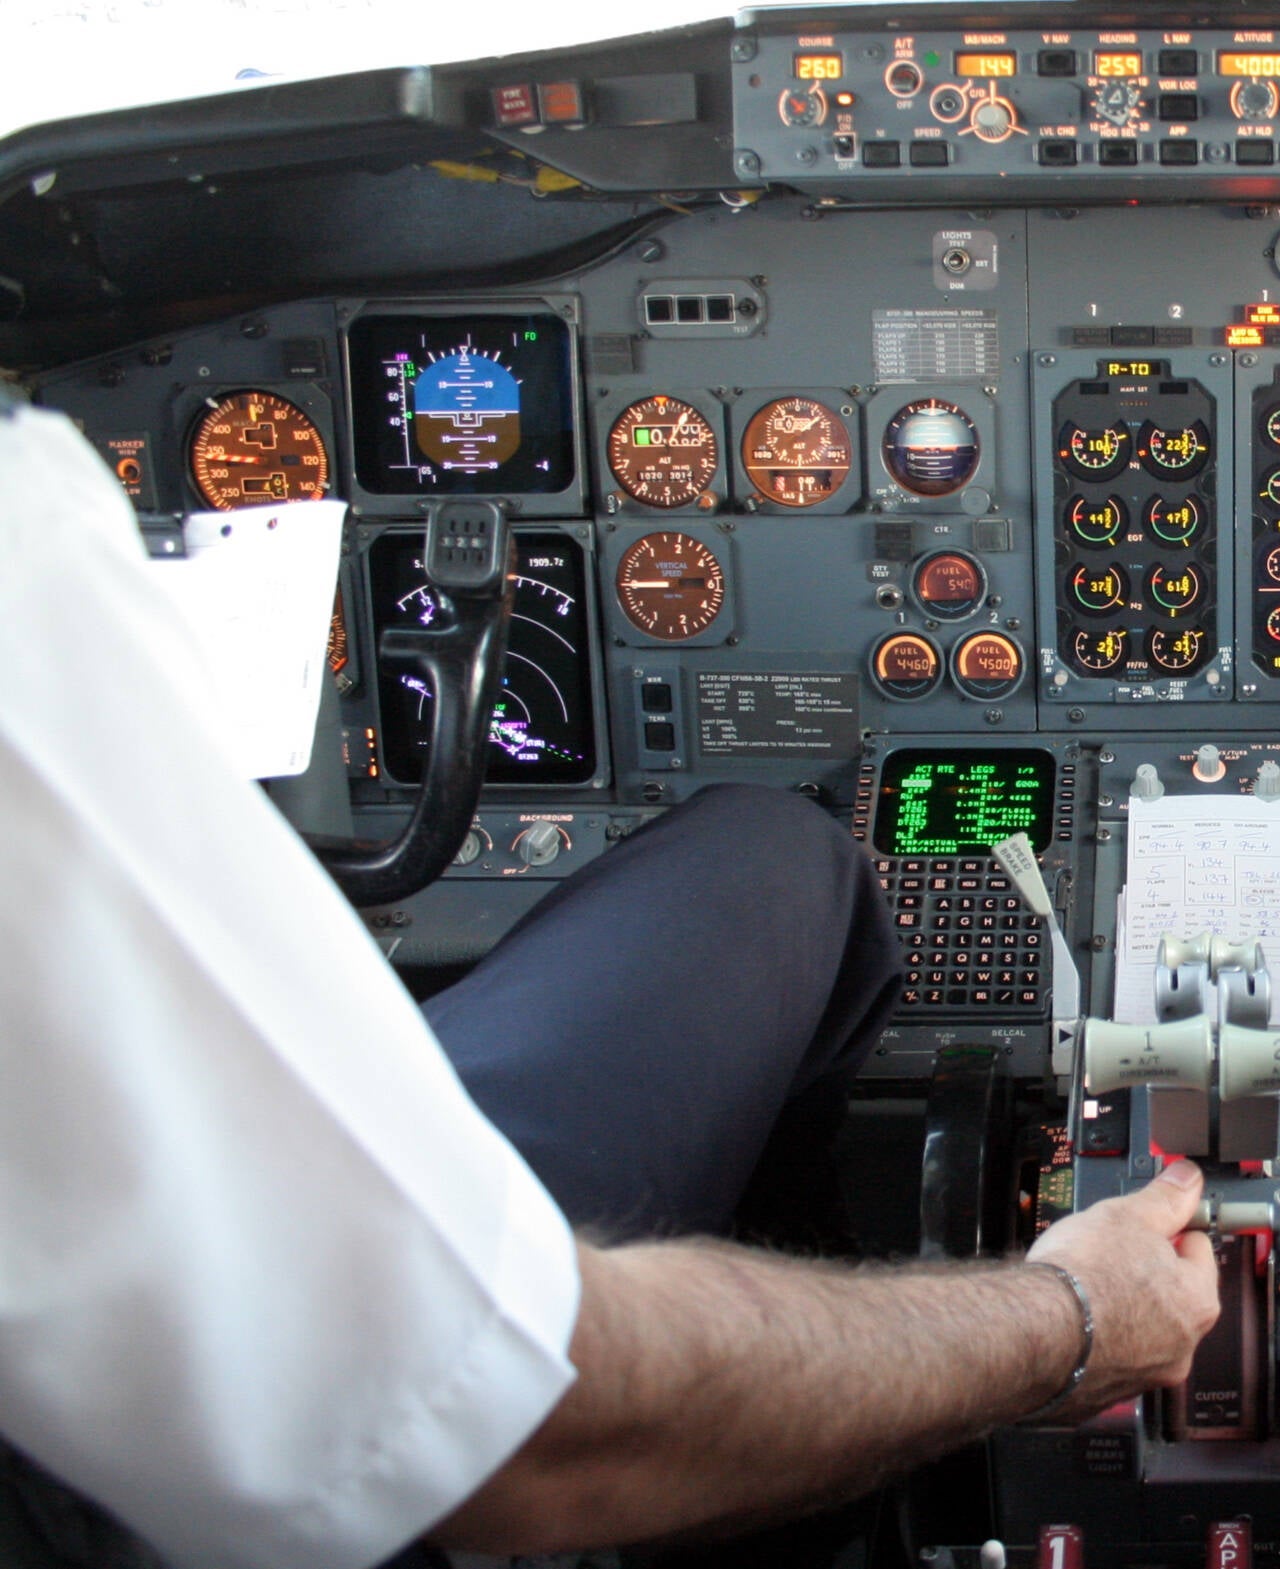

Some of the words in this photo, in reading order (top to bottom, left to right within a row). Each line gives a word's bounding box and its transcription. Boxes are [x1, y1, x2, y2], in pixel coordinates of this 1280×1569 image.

[798, 36, 834, 47] COURSE
[894, 37, 913, 49] A/T
[1042, 34, 1050, 44] V
[1052, 34, 1069, 44] NAV
[1099, 33, 1137, 44] HEADING
[1172, 33, 1190, 44] NAV
[1234, 33, 1274, 43] ALTITUDE
[799, 58, 840, 79] 260
[979, 58, 1014, 77] 144
[1099, 57, 1140, 76] 259
[1262, 289, 1268, 302] 1
[1091, 304, 1097, 317] 1
[1172, 305, 1181, 318] 2
[386, 368, 397, 376] 80
[274, 410, 287, 420] 80
[213, 425, 231, 434] 400
[293, 431, 310, 440] 100
[109, 441, 144, 449] MARKER
[302, 456, 319, 465] 120
[658, 456, 672, 464] ALT
[211, 469, 228, 479] 300
[640, 472, 663, 480] 1020
[222, 488, 240, 498] 250
[1127, 534, 1143, 542] EGT
[937, 567, 960, 575] FUEL
[899, 613, 905, 623] 1
[990, 613, 998, 624] 2
[894, 647, 918, 656] FUEL
[976, 646, 1000, 655] FUEL
[897, 659, 929, 670] 4460
[979, 658, 1010, 670] 4500
[915, 766, 932, 774] ACT
[937, 765, 955, 774] RTE
[970, 765, 995, 774] LEGS
[939, 900, 949, 908] A
[984, 918, 992, 926] H
[981, 936, 991, 944] M
[1005, 936, 1014, 944] N
[1027, 936, 1038, 944] O
[978, 973, 990, 981] W
[1143, 1031, 1154, 1052] 1
[1099, 1106, 1112, 1114] UP
[1195, 1392, 1238, 1400] CUTOFF
[1219, 1533, 1238, 1569] AP
